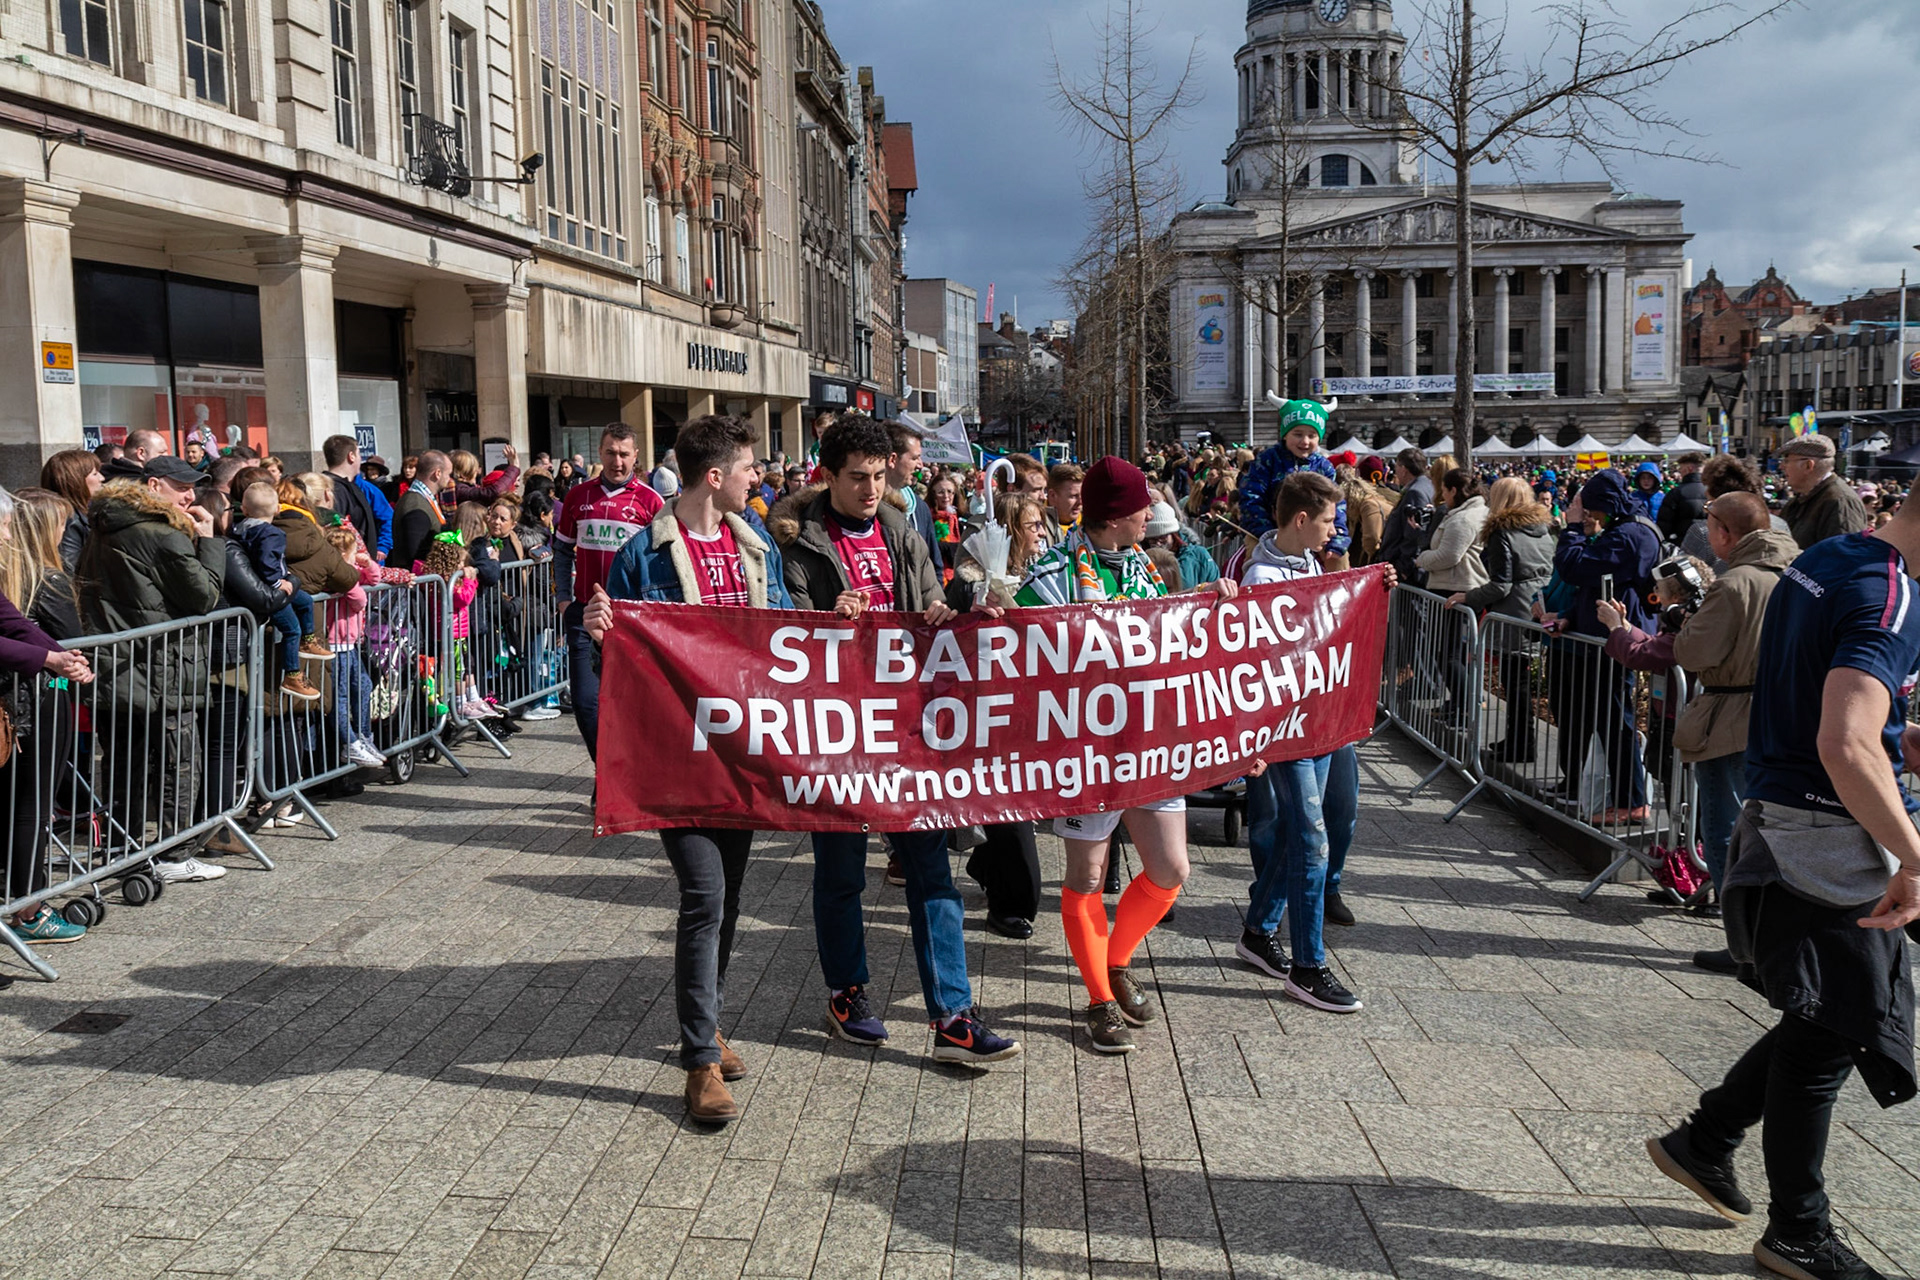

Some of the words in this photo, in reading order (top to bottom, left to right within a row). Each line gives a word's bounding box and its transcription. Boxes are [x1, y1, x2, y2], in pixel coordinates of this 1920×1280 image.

[688, 342, 748, 376] DEBENHAMS
[1331, 380, 1348, 393] Big
[1350, 379, 1391, 391] reader?
[1394, 380, 1415, 390] BIG
[707, 566, 724, 587] 21
[858, 559, 881, 579] 25
[768, 626, 855, 684] ST
[875, 606, 1211, 684] BARNABAS
[1217, 594, 1305, 653] GAC
[692, 697, 899, 756] PRIDE
[922, 692, 1015, 751] OF
[1036, 641, 1353, 742] NOTTINGHAM
